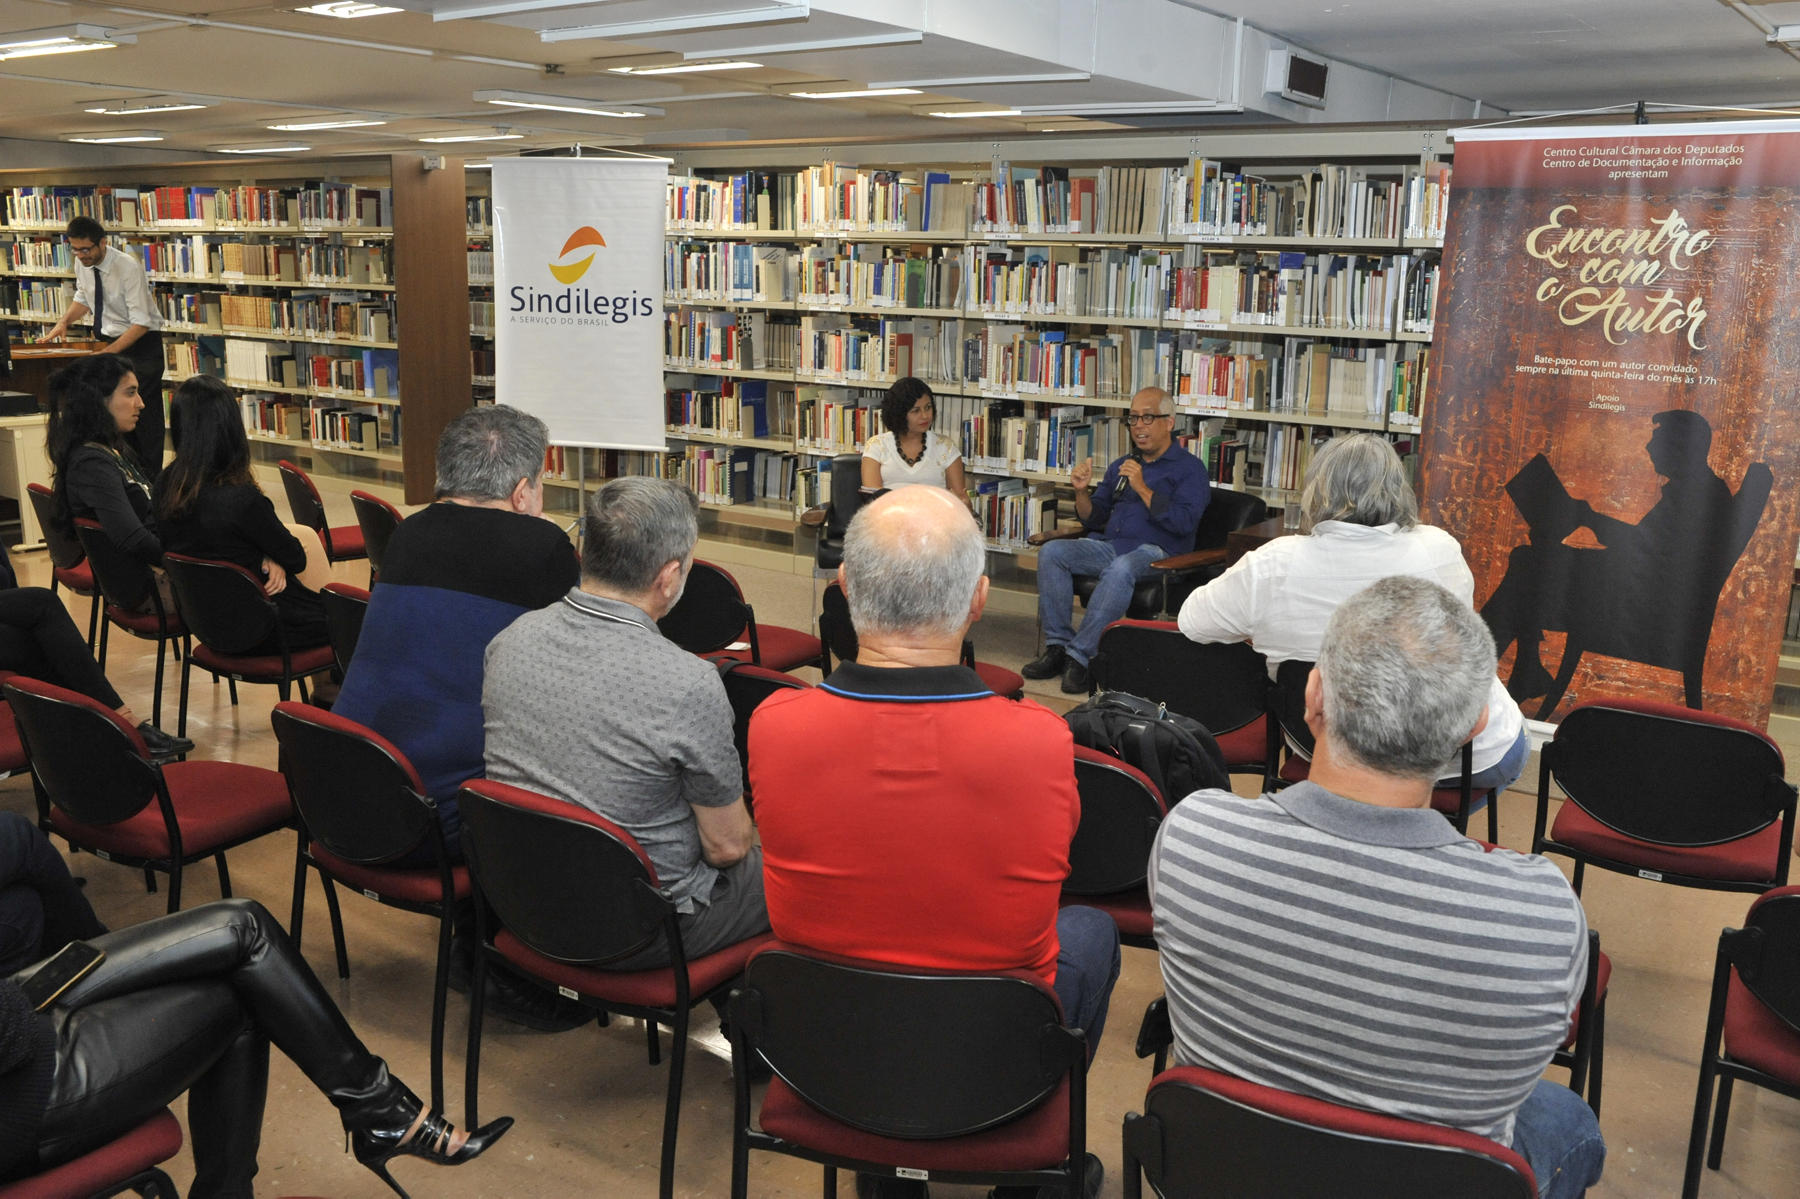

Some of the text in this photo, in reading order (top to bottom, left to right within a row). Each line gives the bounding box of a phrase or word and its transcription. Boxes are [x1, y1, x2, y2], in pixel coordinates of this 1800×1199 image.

[1543, 144, 1745, 157] Centro Cultural Câmara dos Deputados
[1542, 156, 1743, 169] Centro de Documentação e Informação
[1608, 170, 1669, 180] apresentam
[1525, 204, 1718, 271] Encontro
[1579, 257, 1667, 286] com
[510, 285, 653, 324] Sindilegis
[1536, 276, 1708, 350] o Autor
[519, 316, 557, 325] SERVIÇO
[560, 317, 574, 326] DO
[577, 318, 609, 327] BRASIL
[1534, 354, 1698, 374] Bate-papo com um autor convidado
[1515, 364, 1718, 385] sempre na última quinta-feira do mês às 17h
[1596, 393, 1620, 402] Apoio
[1588, 400, 1626, 413] Sindilegis
